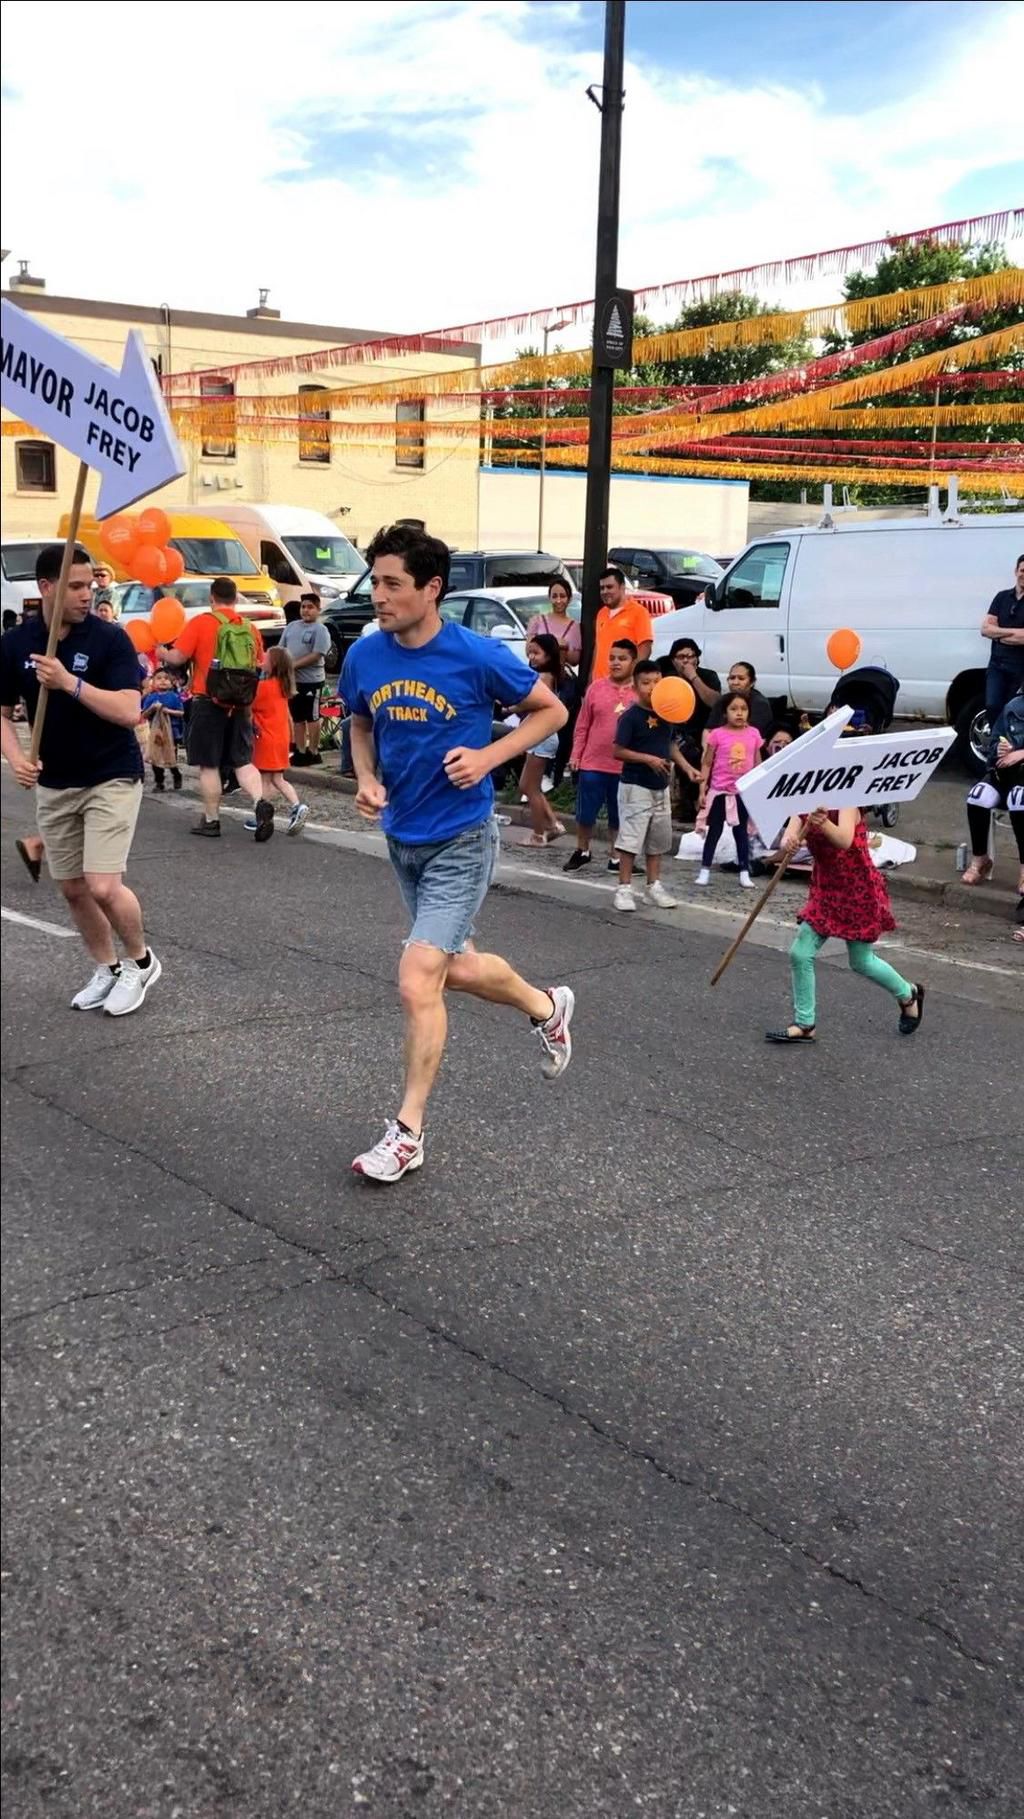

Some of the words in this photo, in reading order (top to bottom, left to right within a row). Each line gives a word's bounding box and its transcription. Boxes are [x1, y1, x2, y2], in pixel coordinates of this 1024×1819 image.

[1, 339, 74, 418] MAYOR
[84, 382, 155, 443] JACOB
[87, 421, 141, 473] FREY
[387, 707, 428, 721] TRACK
[872, 747, 944, 771] JACOB
[767, 765, 864, 800] MAYOR
[864, 773, 922, 795] FREY
